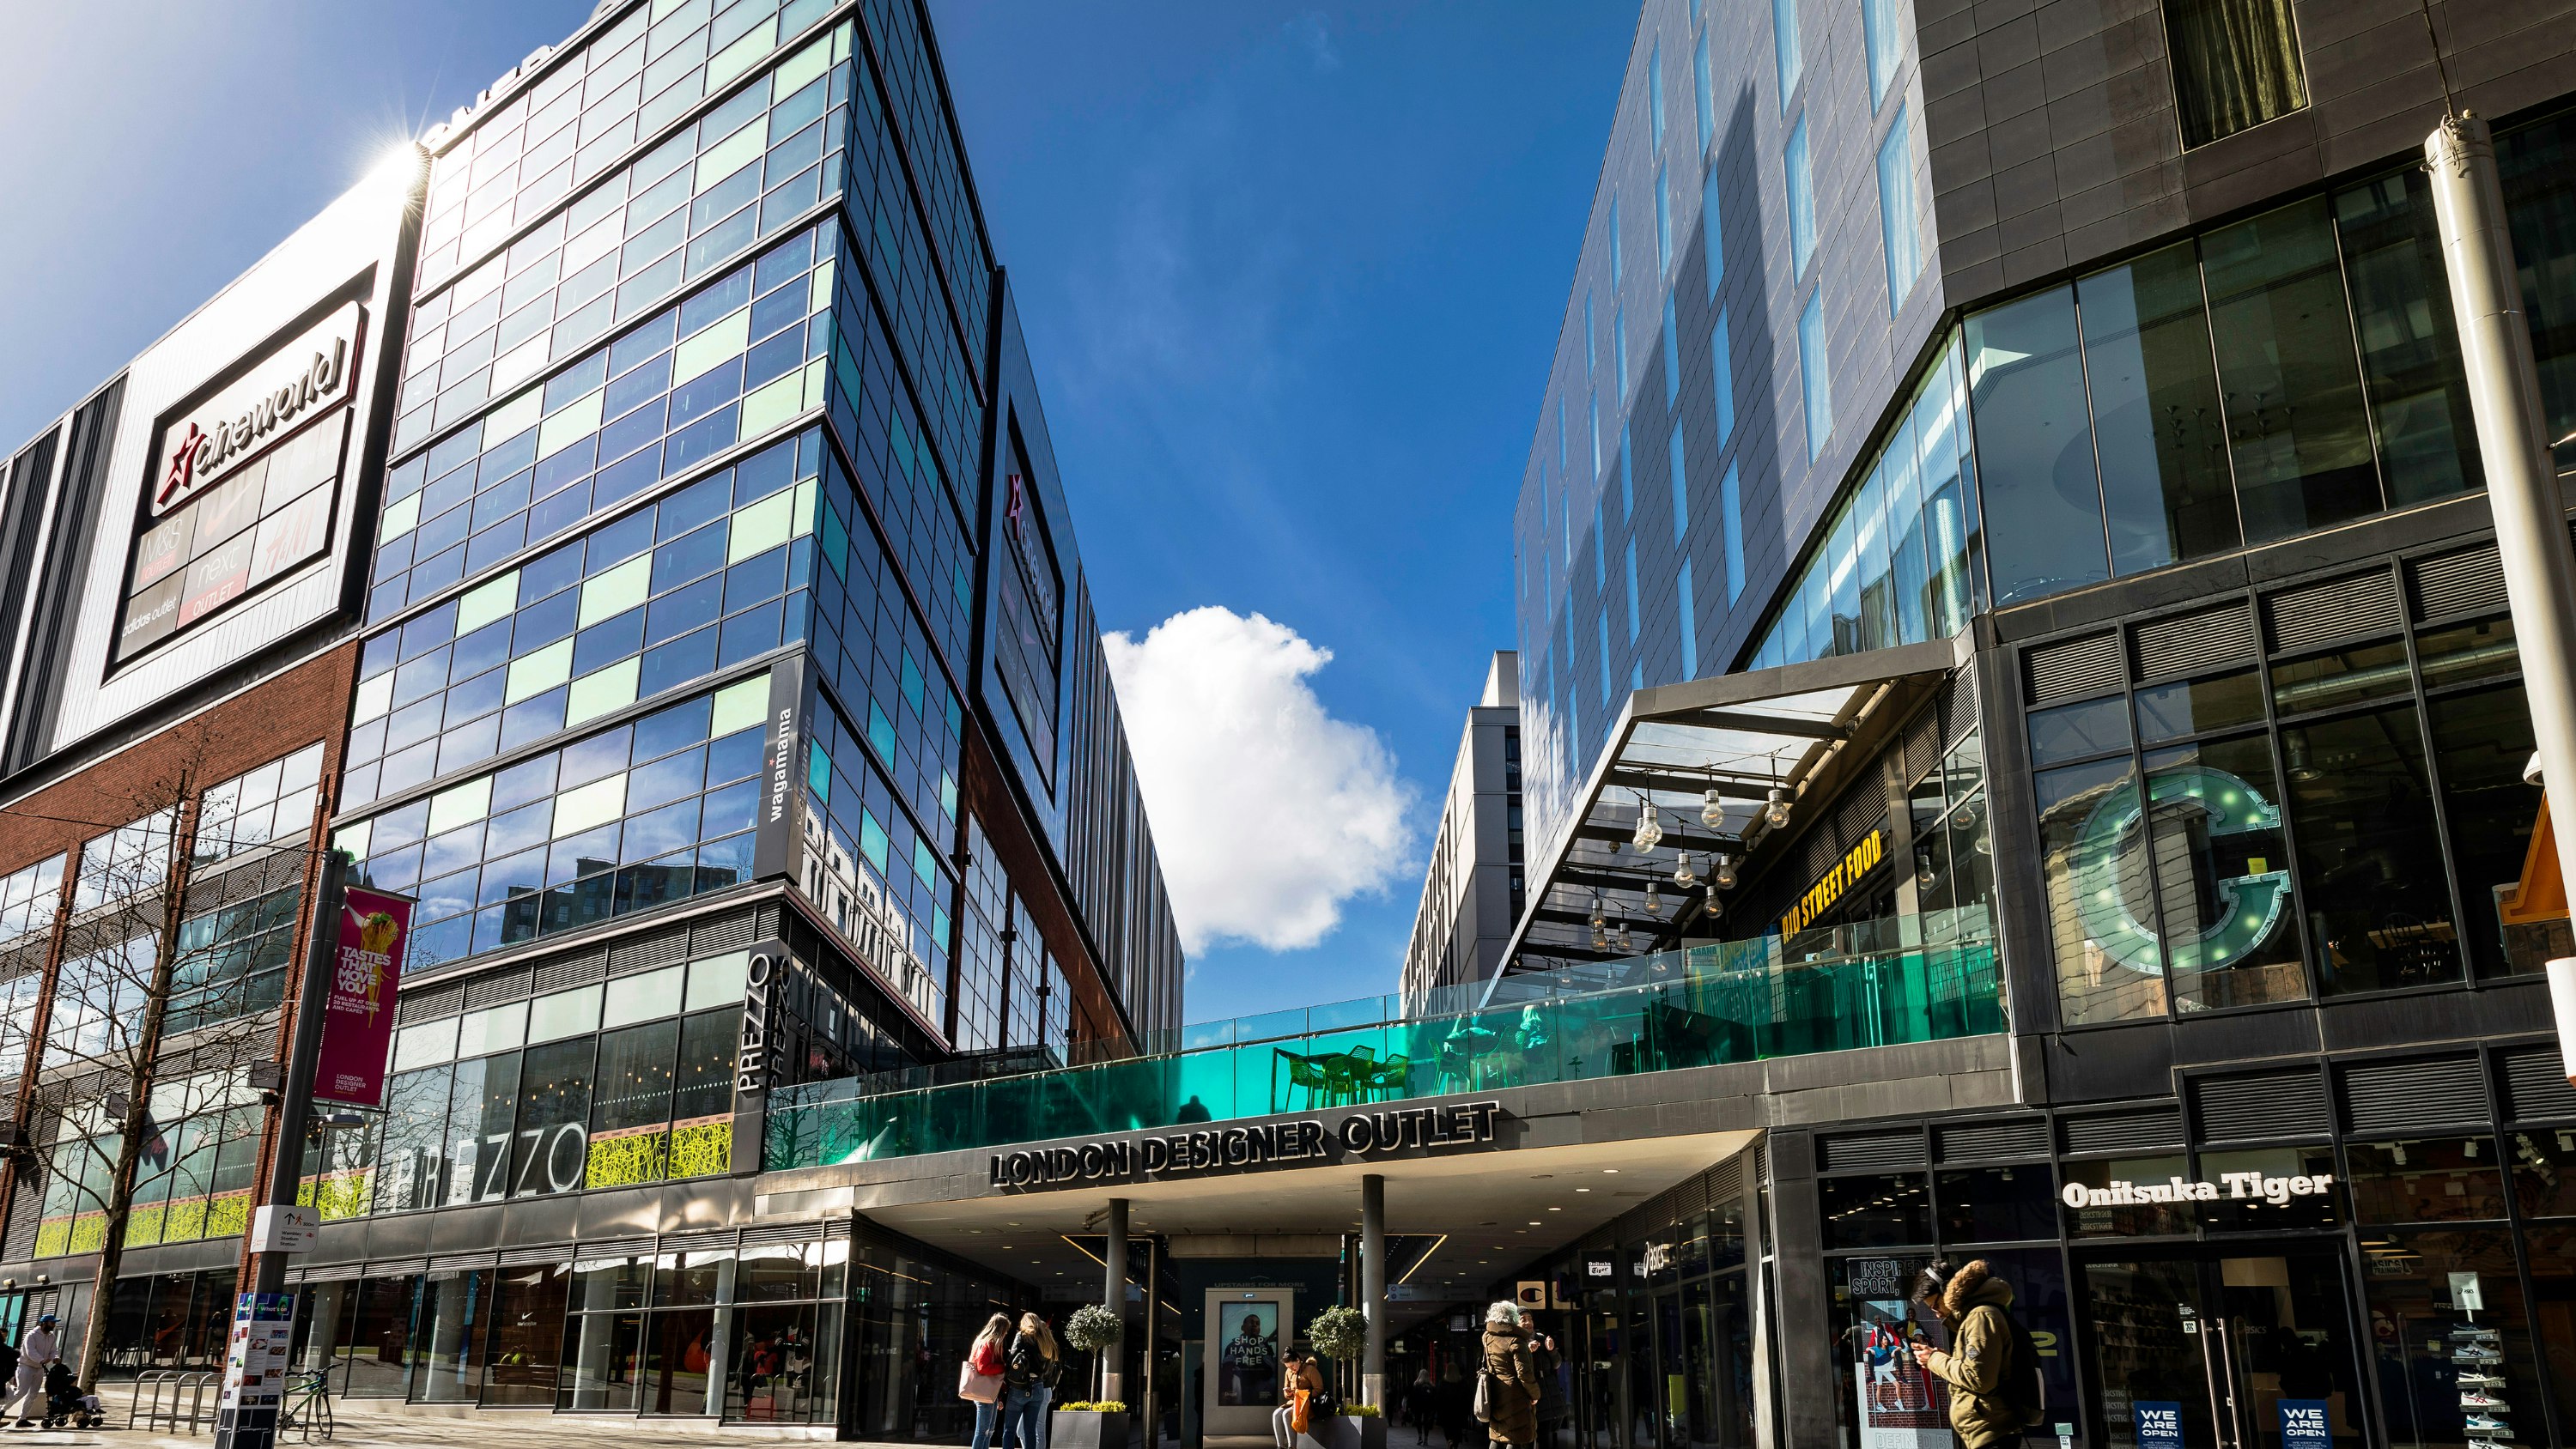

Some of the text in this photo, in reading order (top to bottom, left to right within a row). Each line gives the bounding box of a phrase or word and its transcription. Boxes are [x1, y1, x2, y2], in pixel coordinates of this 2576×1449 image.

[192, 336, 346, 476] cineworld
[143, 518, 182, 566] M&S
[262, 494, 317, 576] H&M
[144, 556, 173, 579] OUTLET
[197, 545, 240, 589] next
[1019, 519, 1057, 646] cineworld
[192, 581, 234, 617] OUTLET
[122, 595, 178, 638] adidas outlet
[771, 708, 792, 823] wagamama
[1782, 829, 1881, 945] RIO STREET FOOD
[341, 957, 376, 973] THAT
[343, 946, 392, 966] TASTES
[337, 967, 377, 985] MOVE
[337, 979, 366, 994] YOU
[341, 1001, 380, 1012] RESTAURANTS
[738, 953, 771, 1092] PREZZO
[336, 1079, 367, 1088] DESIGNER
[989, 1100, 1501, 1188] LONDON DESIGNER OUTLET
[390, 1122, 586, 1213] PREZZO
[2063, 1171, 2334, 1209] Onitsuka Tiger
[1649, 1244, 1665, 1271] asics
[1861, 1259, 1923, 1277] INSPIRED
[1852, 1277, 1900, 1296] SPORT,
[1230, 1346, 1268, 1355] HANDS
[1235, 1336, 1264, 1346] SHOP
[1236, 1356, 1262, 1366] FREE
[2141, 1410, 2177, 1420] WE
[2284, 1409, 2324, 1419] WE
[2286, 1420, 2324, 1428] ARE
[2142, 1421, 2178, 1429] ARE
[1875, 1432, 1953, 1449] DEFINED BY
